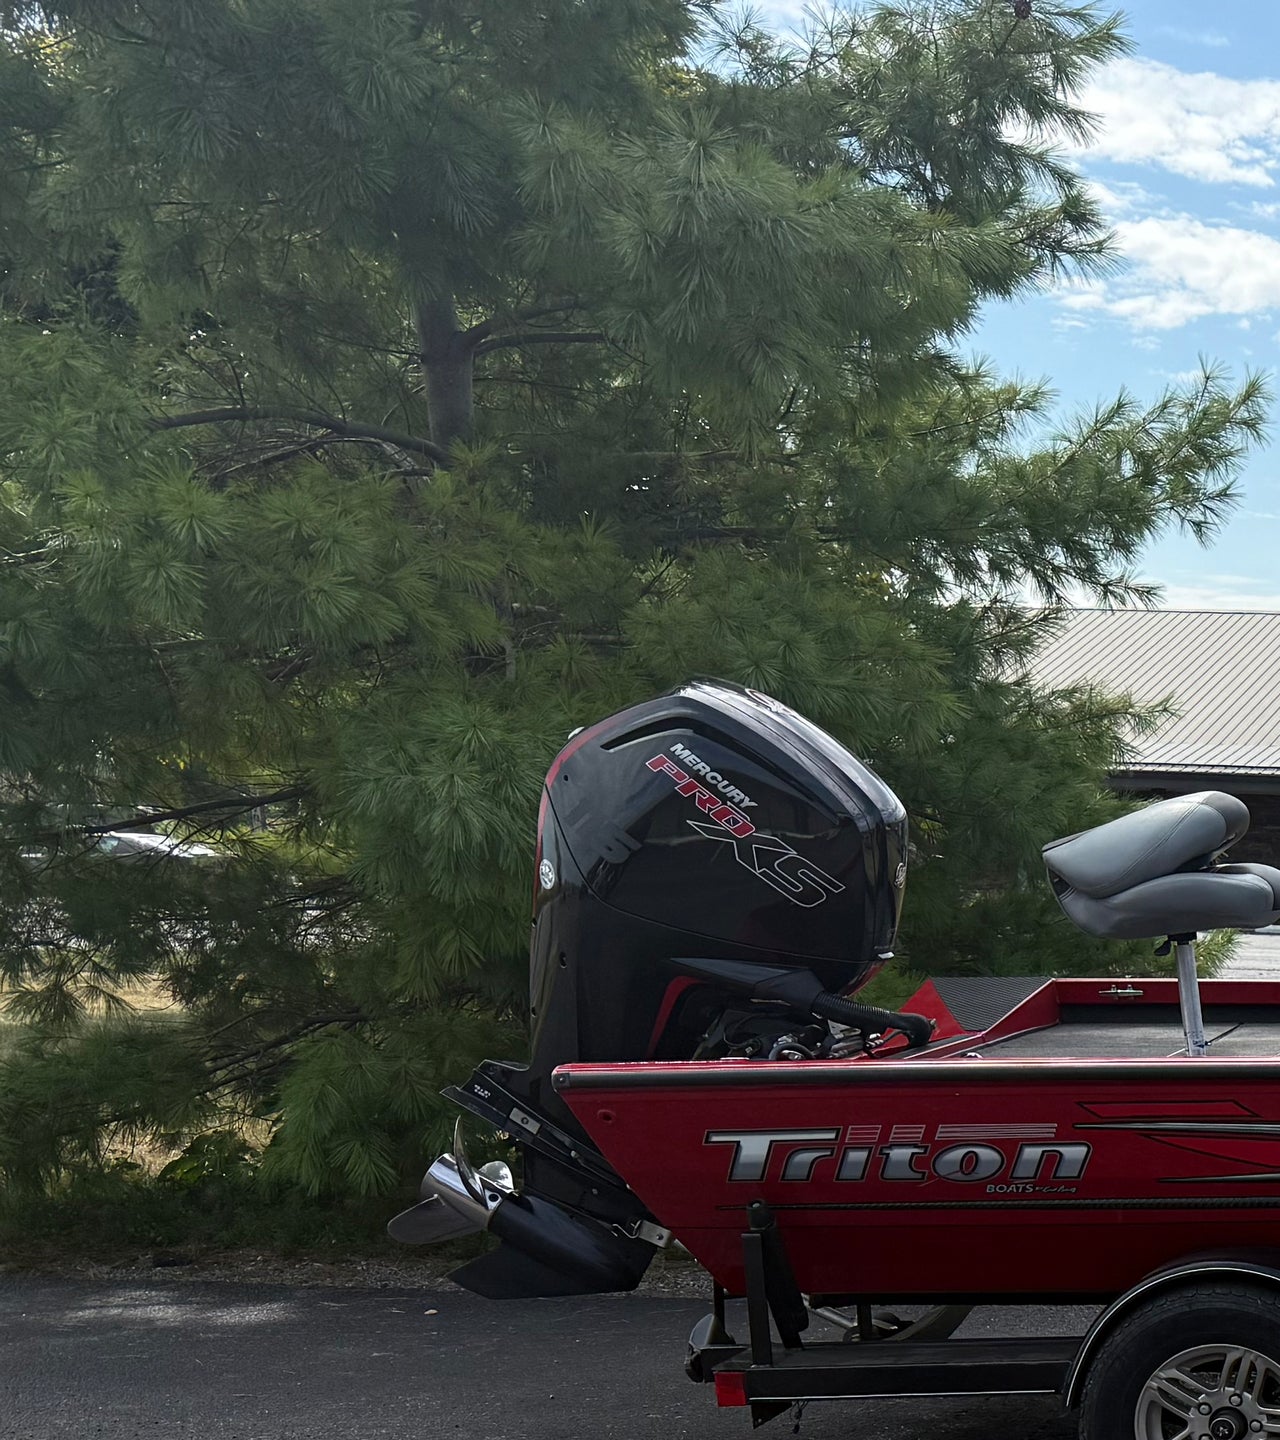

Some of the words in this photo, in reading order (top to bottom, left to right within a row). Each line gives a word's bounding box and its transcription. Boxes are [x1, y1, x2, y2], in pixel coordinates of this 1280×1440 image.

[645, 753, 756, 838] PRO
[669, 742, 758, 809] MERCURY
[686, 820, 846, 908] XS
[703, 1125, 1092, 1184] Triton
[985, 1184, 1034, 1193] BOATS
